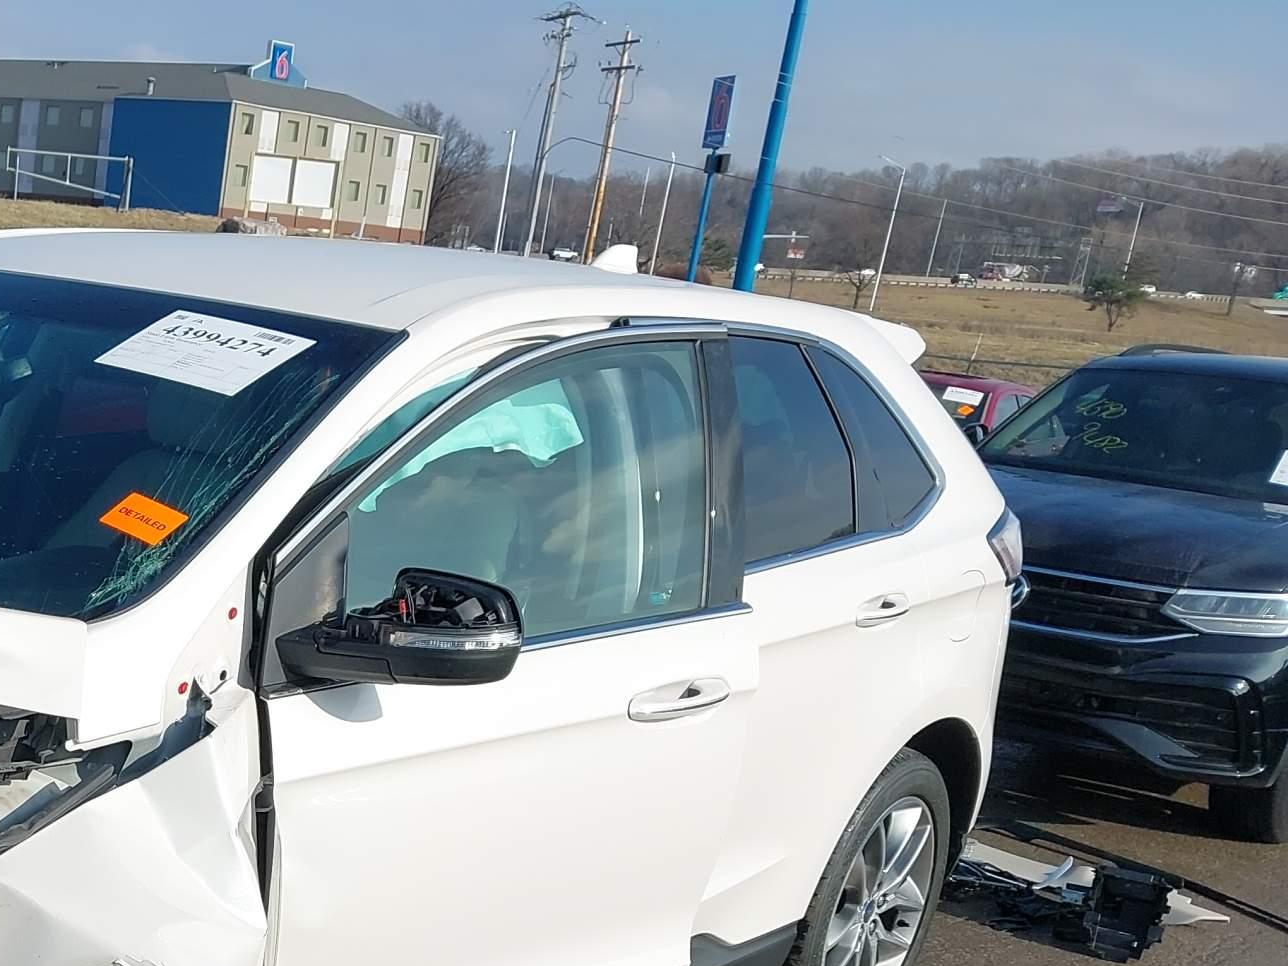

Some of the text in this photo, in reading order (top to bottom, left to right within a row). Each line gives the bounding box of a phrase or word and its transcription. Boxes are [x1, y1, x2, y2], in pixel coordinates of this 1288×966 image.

[275, 50, 289, 80] 6
[712, 82, 729, 131] 6
[162, 324, 278, 358] 43994274
[118, 506, 167, 531] DETAILED
